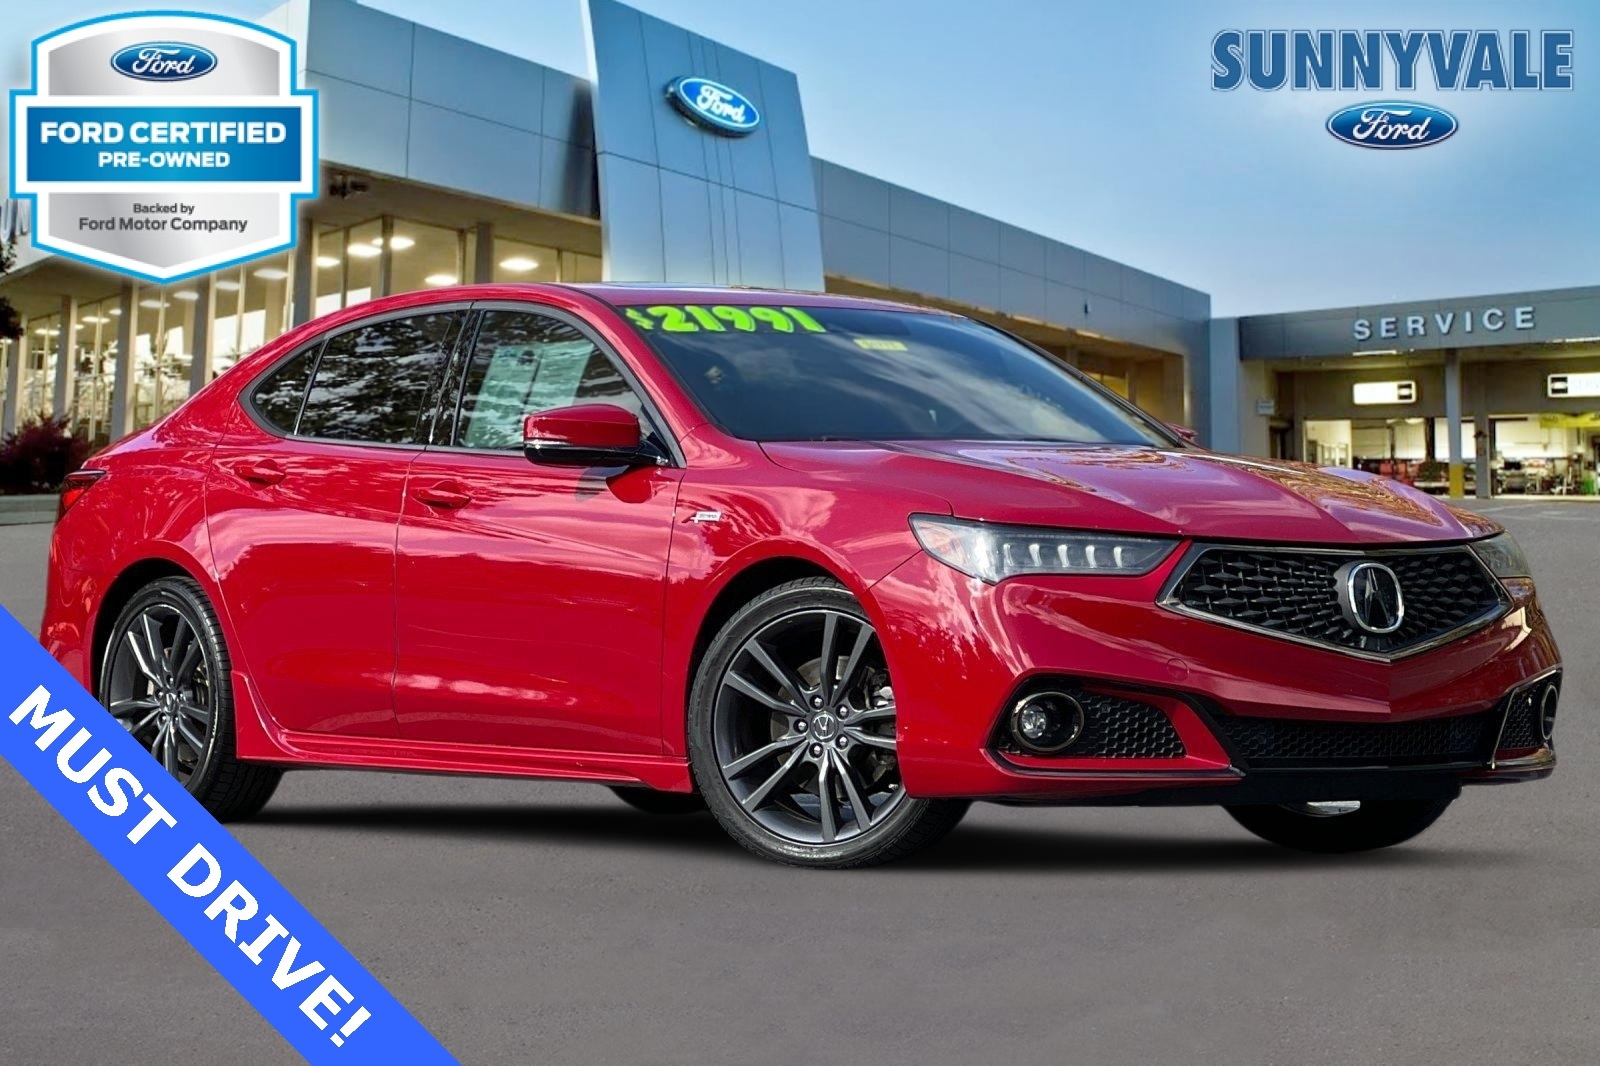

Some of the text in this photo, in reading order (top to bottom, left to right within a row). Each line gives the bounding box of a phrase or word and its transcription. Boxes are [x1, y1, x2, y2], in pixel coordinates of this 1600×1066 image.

[697, 85, 746, 122] Ford
[625, 305, 826, 332] $21991
[1353, 305, 1536, 342] SERVICE
